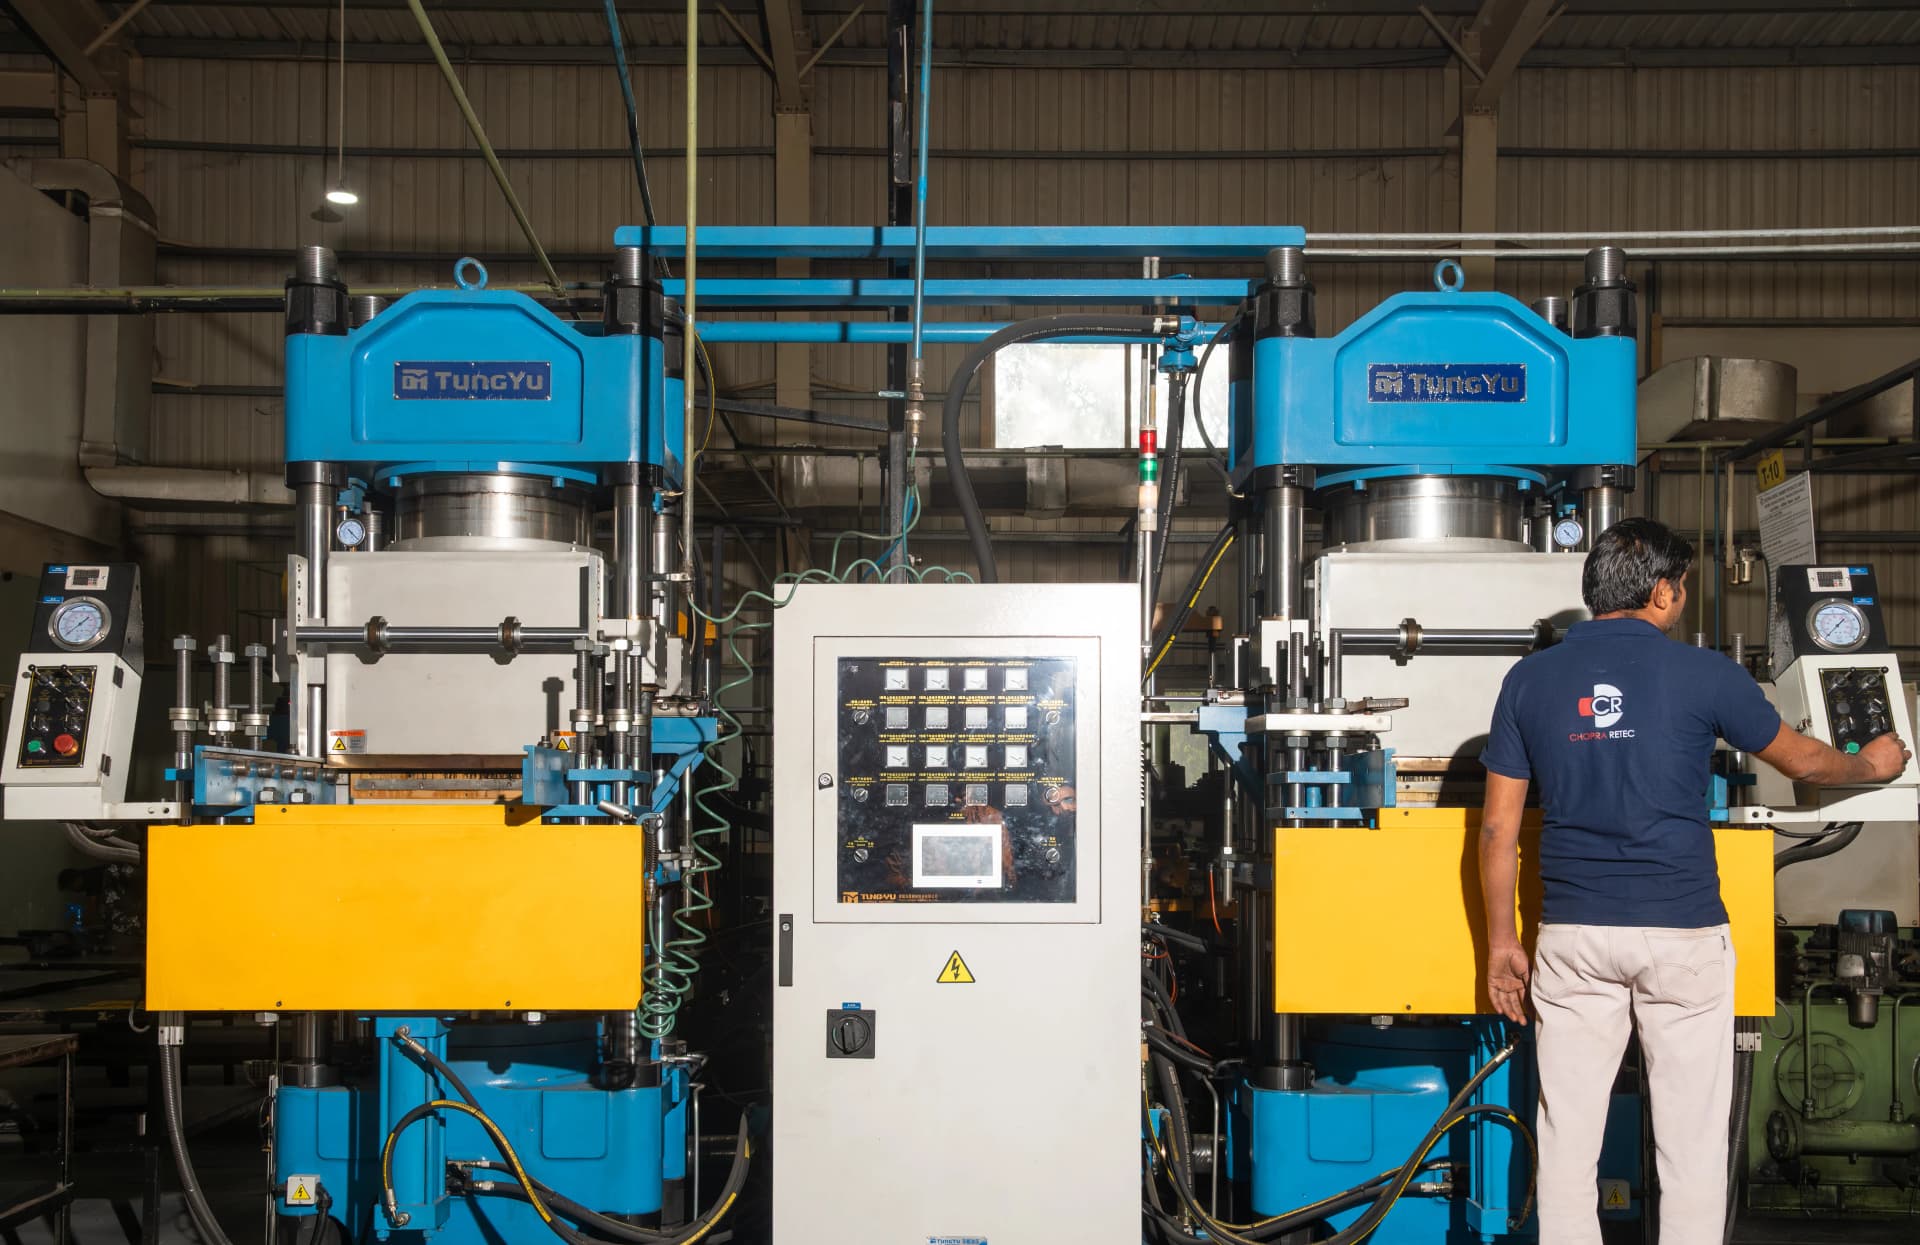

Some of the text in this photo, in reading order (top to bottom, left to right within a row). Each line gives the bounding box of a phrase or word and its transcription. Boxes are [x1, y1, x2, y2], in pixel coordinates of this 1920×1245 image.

[1761, 460, 1780, 485] T-10
[1592, 696, 1622, 715] CR
[1569, 729, 1635, 742] CHOPRA RETEC
